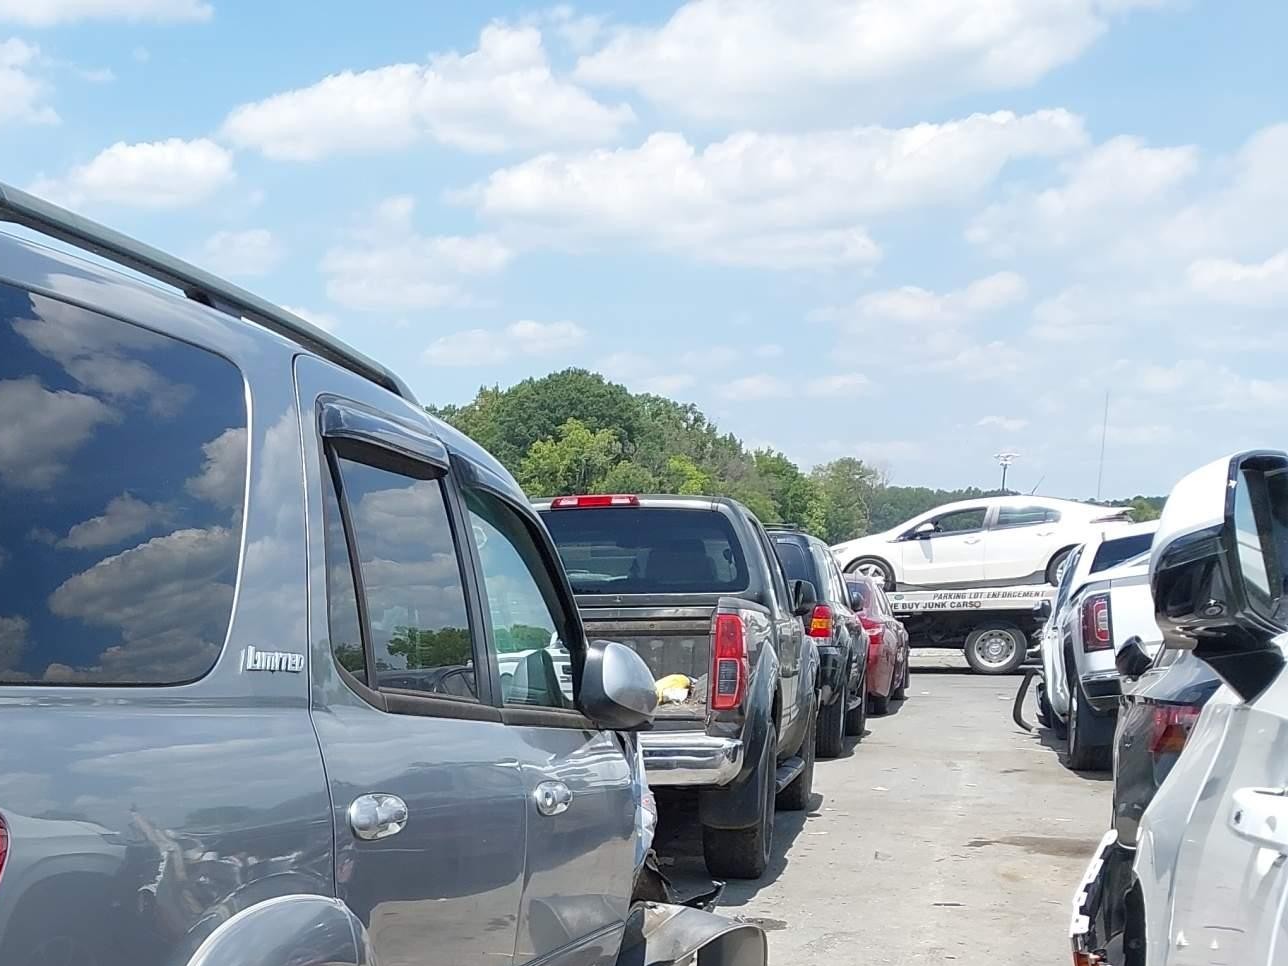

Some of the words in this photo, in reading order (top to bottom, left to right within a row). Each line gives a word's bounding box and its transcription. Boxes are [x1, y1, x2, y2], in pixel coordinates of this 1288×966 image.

[933, 592, 967, 600] PARKING
[987, 591, 1045, 599] ENFORCEMENT
[923, 601, 947, 609] JUNK
